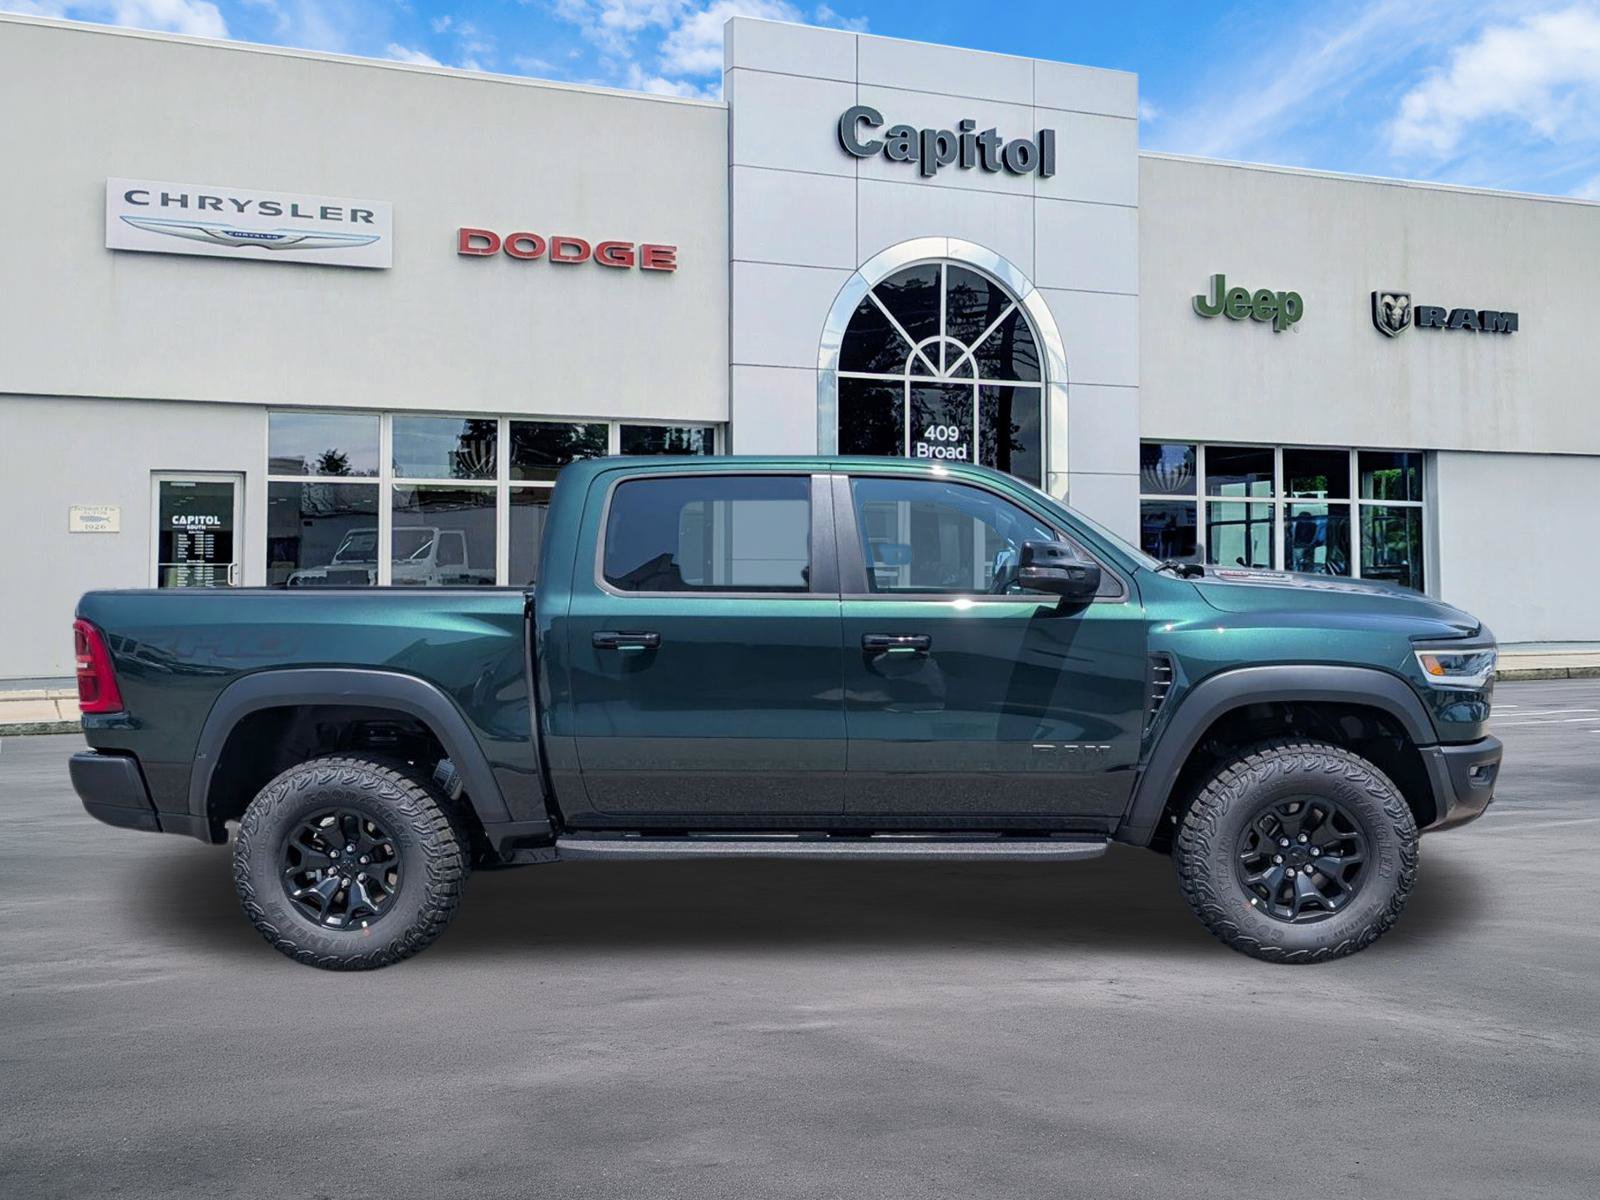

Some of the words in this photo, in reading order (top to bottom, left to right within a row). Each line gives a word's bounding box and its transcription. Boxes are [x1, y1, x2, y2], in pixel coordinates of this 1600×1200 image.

[838, 105, 1056, 178] Capitol
[123, 190, 375, 225] CHRYSLER
[457, 227, 677, 272] DODGE
[1192, 273, 1304, 333] Jeep
[1414, 304, 1519, 333] RAM
[924, 425, 959, 441] 409
[917, 442, 967, 459] Broad
[172, 515, 221, 525] CAPITOL
